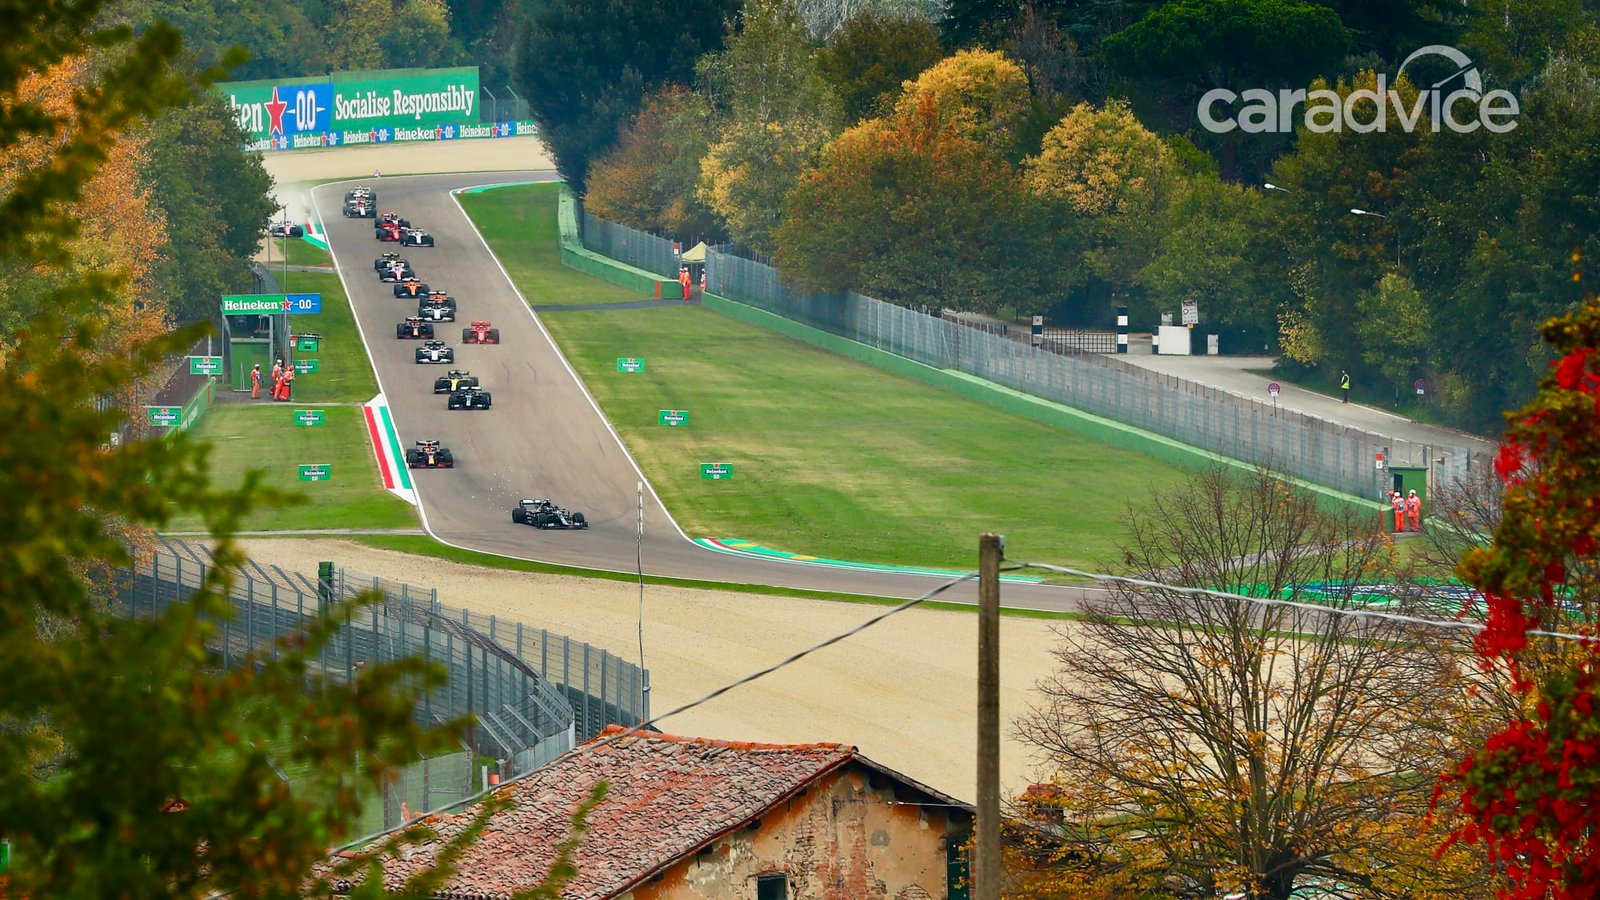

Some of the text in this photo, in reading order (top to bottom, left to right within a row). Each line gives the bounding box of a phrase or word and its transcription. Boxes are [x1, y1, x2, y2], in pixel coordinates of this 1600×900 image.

[335, 84, 475, 120] Socialise Responsibly
[293, 133, 320, 148] Heineken
[343, 130, 370, 144] Heineken
[394, 127, 435, 140] Heineken
[459, 124, 491, 138] Heineken
[224, 300, 278, 311] Heineken
